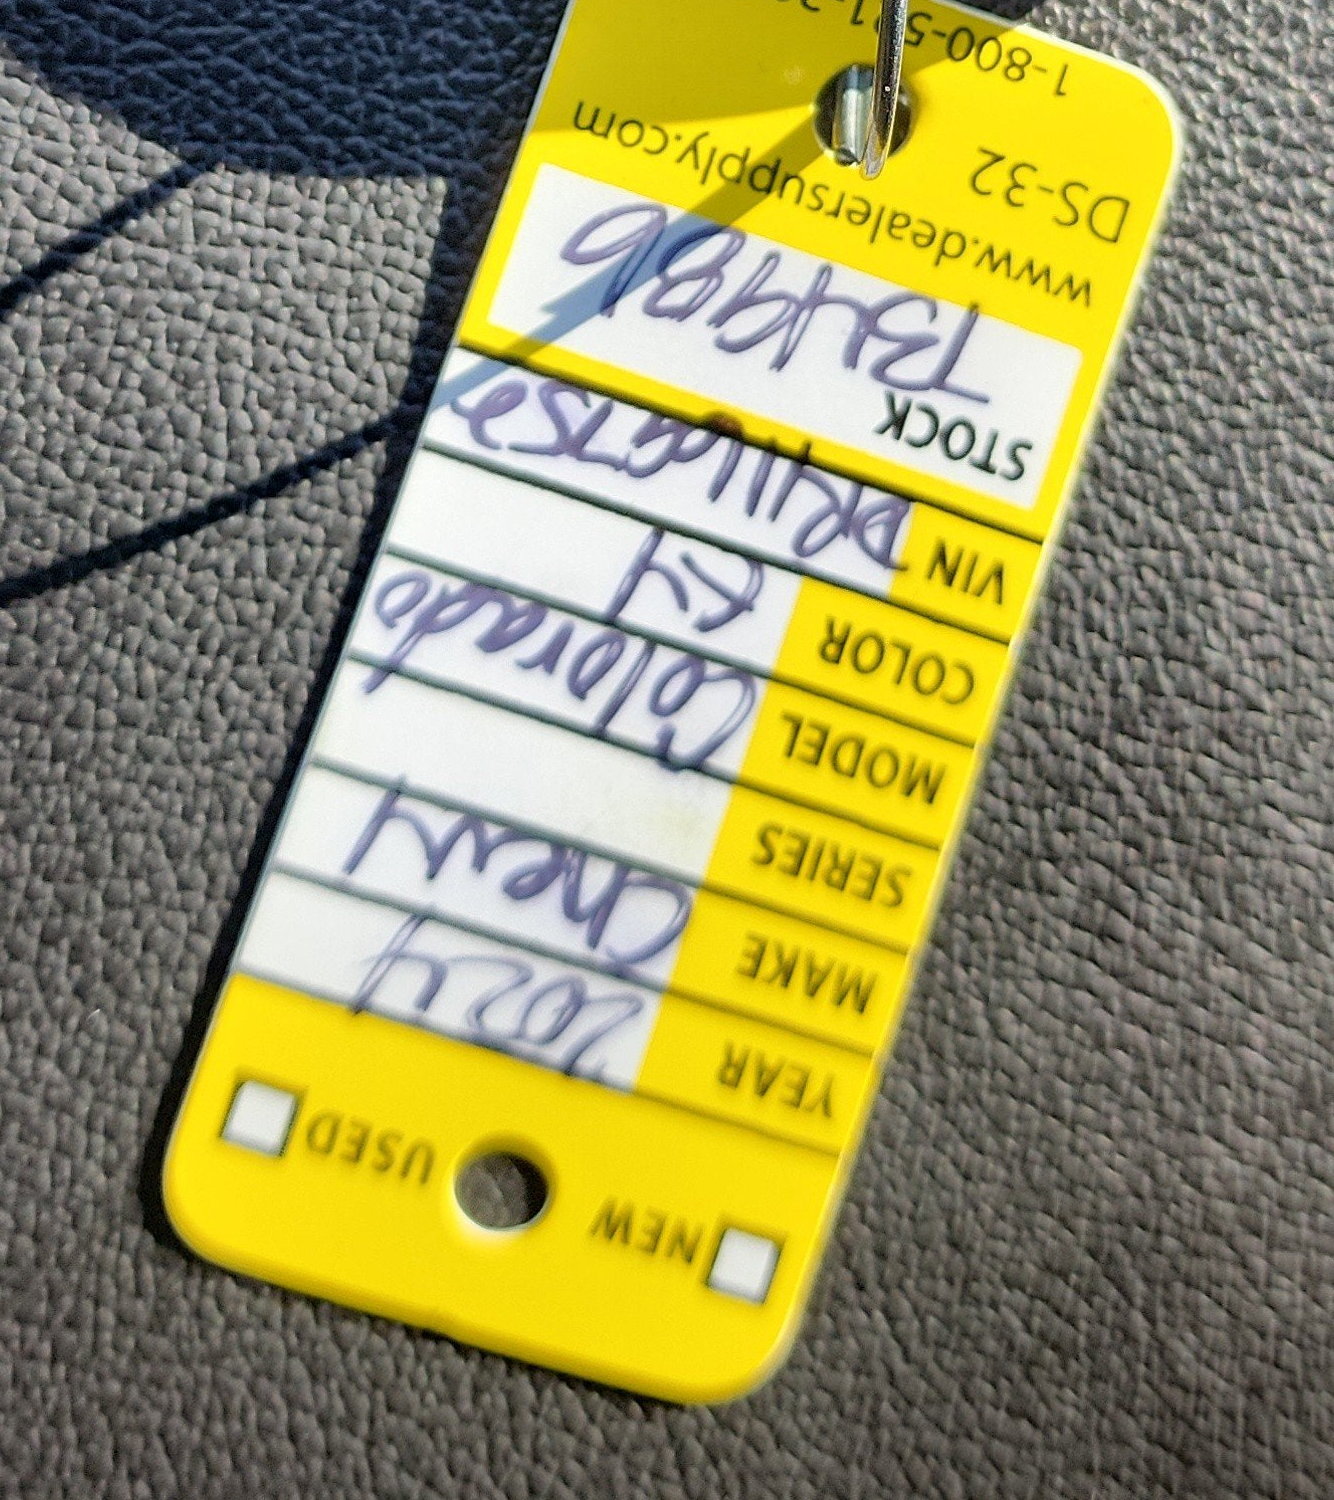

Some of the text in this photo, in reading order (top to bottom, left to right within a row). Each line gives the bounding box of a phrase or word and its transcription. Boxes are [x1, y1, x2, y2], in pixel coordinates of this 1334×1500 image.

[573, 100, 1092, 309] www.dealersupply.com
[969, 146, 1131, 245] DS-32
[878, 393, 1033, 482] STOCK
[926, 535, 1006, 606] VIN
[362, 567, 758, 772] Colorado
[818, 614, 975, 705] COLOR
[778, 709, 947, 806] MODEL
[343, 775, 693, 966] Chevy
[751, 820, 914, 909] SERIES
[350, 914, 647, 1091] 2024
[735, 931, 879, 1016] MAKE
[717, 1038, 838, 1120] YEAR
[304, 1106, 438, 1187] USED
[588, 1195, 706, 1267] NEW
